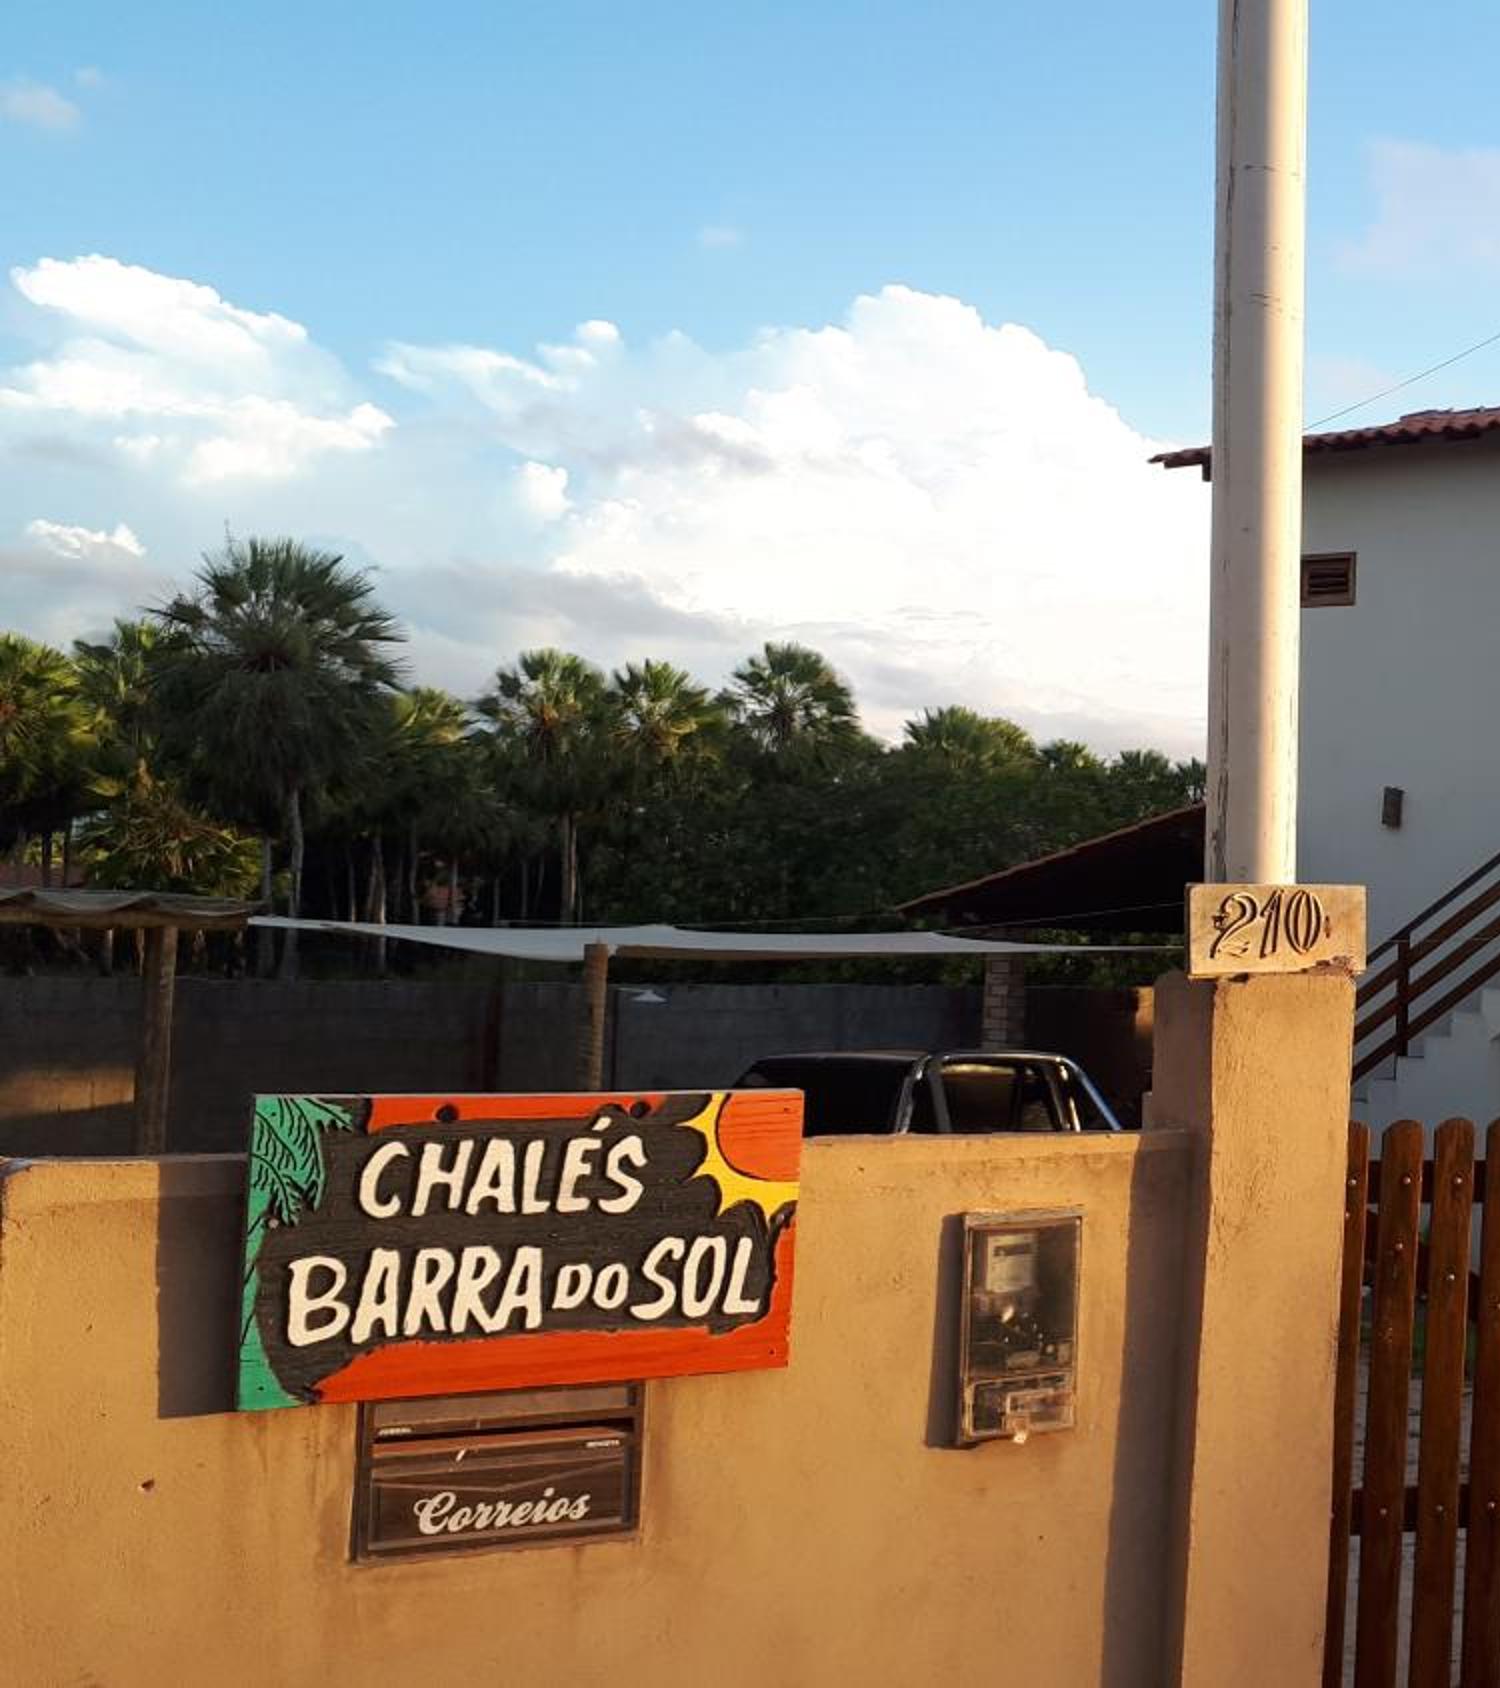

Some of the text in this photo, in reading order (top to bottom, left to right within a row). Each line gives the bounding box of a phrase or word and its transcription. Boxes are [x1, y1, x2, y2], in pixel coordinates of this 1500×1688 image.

[1211, 889, 1323, 959] 210
[358, 1116, 649, 1218] CHALÉS
[287, 1236, 760, 1347] BARRA DO SOL
[413, 1488, 591, 1535] Correios
